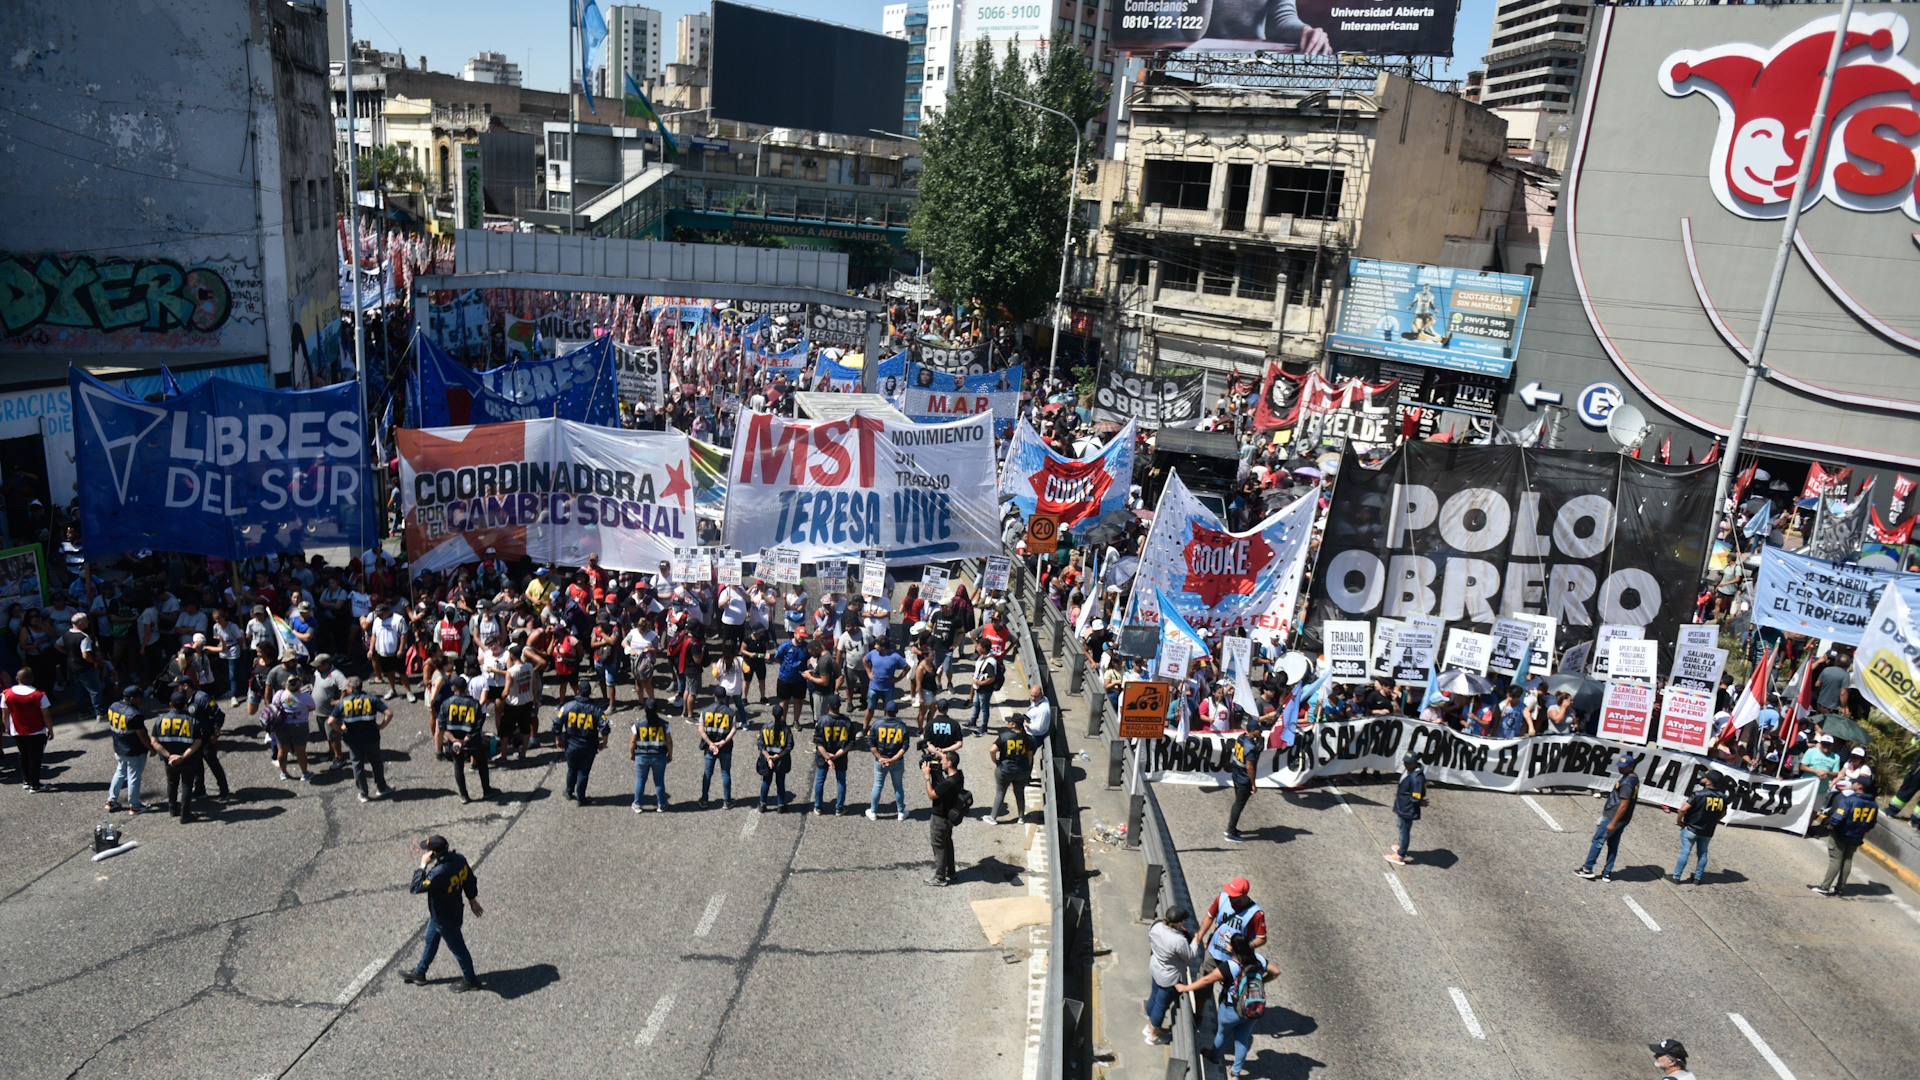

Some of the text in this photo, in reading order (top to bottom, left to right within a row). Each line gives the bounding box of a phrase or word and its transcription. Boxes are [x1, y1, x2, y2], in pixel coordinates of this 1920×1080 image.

[1331, 7, 1434, 17] Universidad Abierta
[1123, 15, 1203, 29] 0810-122-1222
[1341, 21, 1419, 31] Interamericana
[733, 221, 804, 235] BIENVENIDOS
[818, 229, 887, 242] AVELLANEDA
[1358, 262, 1397, 271] FORMACIONES
[1381, 270, 1408, 278] LABORAL
[1459, 292, 1513, 304] CUOTAS FIJAS
[742, 301, 800, 313] OBRERO
[540, 316, 591, 339] MULCS
[814, 314, 866, 333] OBRER
[1464, 316, 1507, 328] ENVIÁ SMS
[1449, 324, 1510, 338] 11-6016-7096
[614, 351, 658, 375] ULCS
[921, 346, 975, 366] POLO
[483, 352, 595, 405] LIBRES
[1110, 372, 1178, 401] POLO
[1456, 384, 1496, 404] IPEF.
[1098, 388, 1192, 420] OBRERO
[1589, 392, 1609, 416] E
[48, 415, 73, 436] DIE
[170, 411, 361, 467] LIBRES
[892, 425, 984, 446] MOVIMIENTO
[740, 414, 884, 488] MST
[165, 466, 358, 516] DEL SUR
[415, 462, 656, 506] COORDINADORA
[1044, 474, 1096, 503] COOKE
[416, 506, 445, 525] POR
[447, 492, 685, 539] CAMBIO SOCIAL
[775, 488, 950, 545] TERESA VIVE
[1386, 483, 1616, 559] POLO
[429, 524, 445, 539] EL
[1036, 522, 1051, 535] 20
[1192, 539, 1250, 575] COOKE
[1326, 549, 1662, 627] OBRERO
[1804, 572, 1869, 593] 12 DE ABRIL
[1815, 587, 1862, 609] VARELA
[1773, 597, 1866, 628] EL TROPEZON
[1221, 614, 1290, 633] LA TEJA
[1331, 631, 1364, 643] TRABAJO
[1462, 637, 1478, 645] BASTA
[1611, 629, 1627, 637] BASTA
[1331, 643, 1364, 656] GENUINO
[1463, 644, 1482, 653] AJUSTE
[1687, 650, 1714, 660] SALARIO
[1490, 660, 1513, 668] OBRERO
[1682, 656, 1701, 665] IGUAL
[1683, 663, 1712, 673] CANASTA
[1613, 686, 1647, 696] ASAMBLEA
[1681, 679, 1706, 687] POLO
[1611, 693, 1646, 703] CONSTITUYENTE
[1624, 701, 1647, 710] SOBERANA
[1671, 696, 1706, 706] ABAJO
[343, 698, 372, 716] PFA
[449, 704, 475, 723] PFA
[1688, 704, 1707, 712] ASESINO
[108, 709, 128, 731] PFA
[568, 711, 593, 730] PFA
[705, 712, 729, 730] PFA
[1608, 712, 1644, 722] ATraPer
[161, 718, 191, 737] PFA
[639, 726, 665, 742] PFA
[824, 726, 848, 742] PFA
[933, 723, 951, 735] PFA
[1666, 720, 1704, 732] ATraPer
[878, 727, 903, 744] PFA
[1272, 732, 1314, 773] POR
[1319, 719, 1403, 767] SALARIO
[1409, 725, 1487, 772] CONTRA
[1494, 743, 1520, 778] EL
[1643, 755, 1682, 792] LA
[1684, 763, 1793, 816] PBREZA
[1706, 797, 1724, 812] PFA
[1852, 807, 1876, 823] PFA
